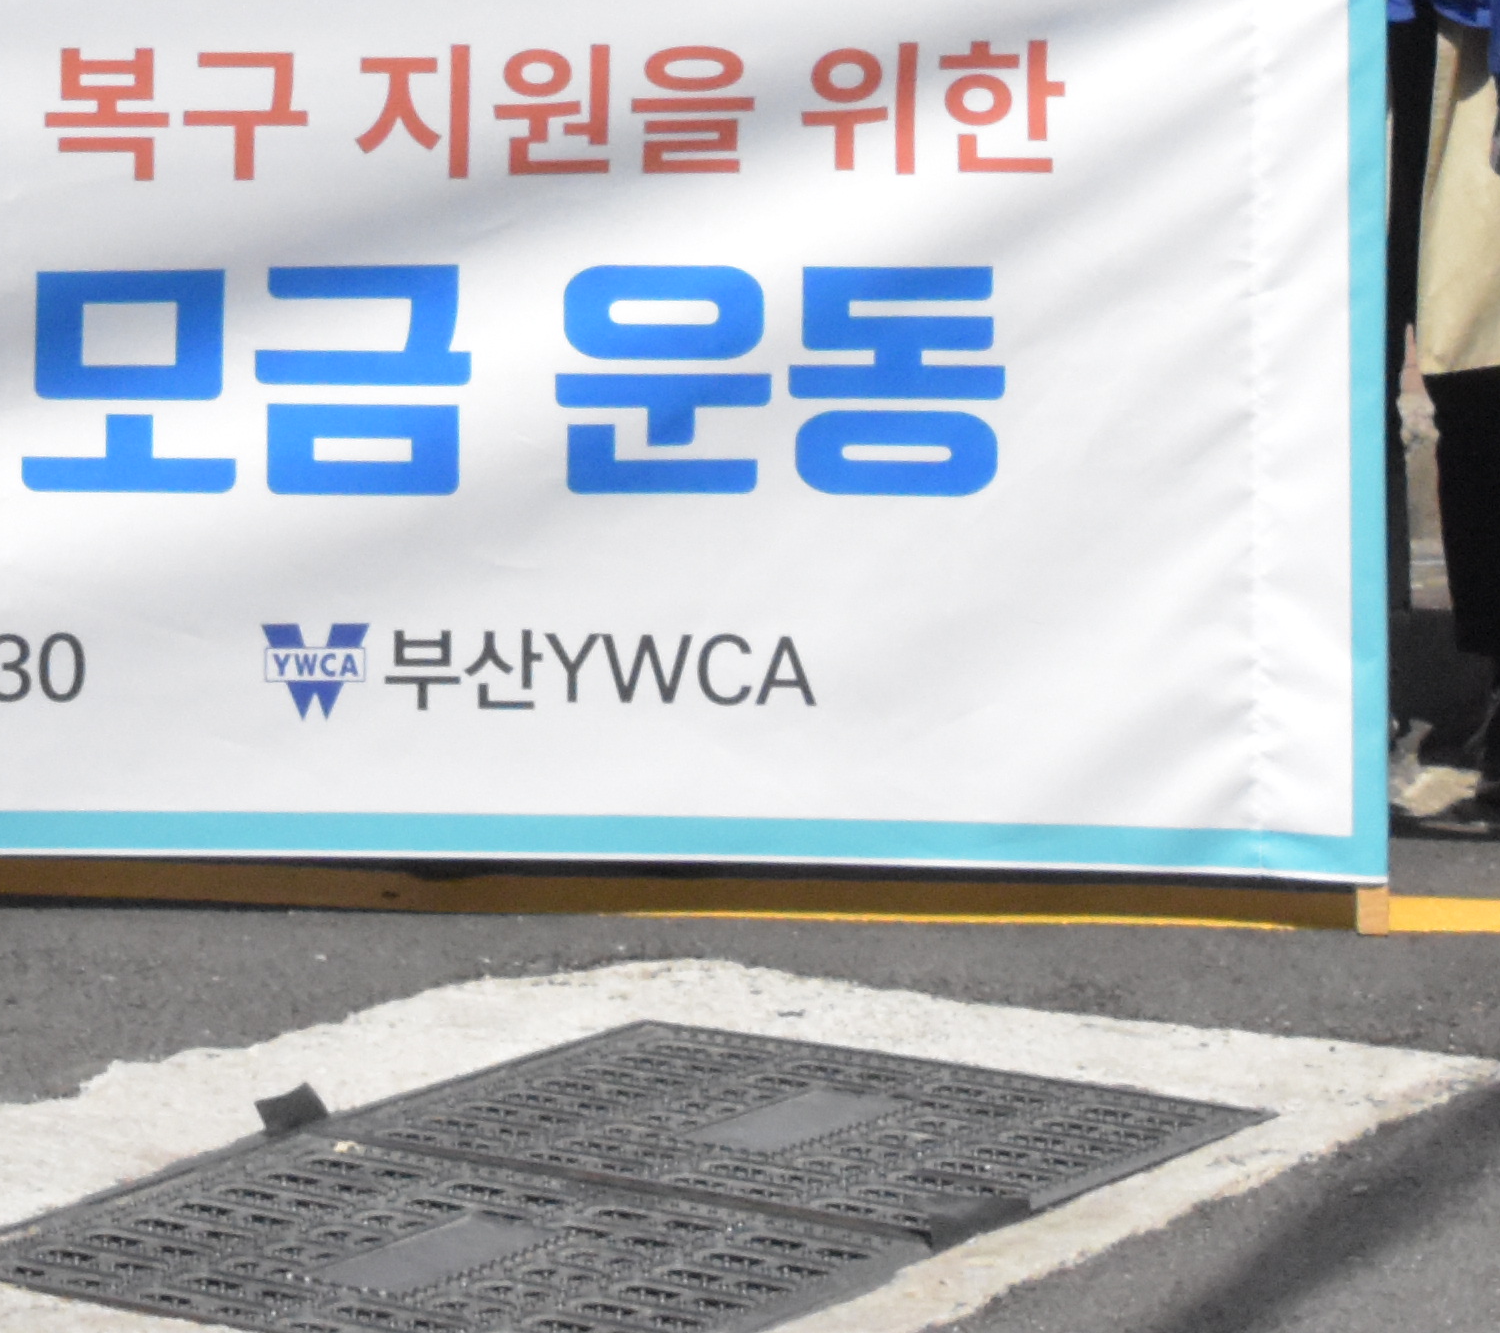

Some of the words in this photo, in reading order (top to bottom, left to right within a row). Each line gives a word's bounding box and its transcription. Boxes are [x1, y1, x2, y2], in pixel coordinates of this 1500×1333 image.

[44, 46, 309, 183] 복구
[354, 43, 756, 180] 지원을
[800, 39, 1066, 176] 위한
[20, 263, 473, 498] 모금
[555, 263, 1007, 498] 운동
[268, 651, 362, 679] YWCA
[383, 627, 818, 713] 부산YWCA
